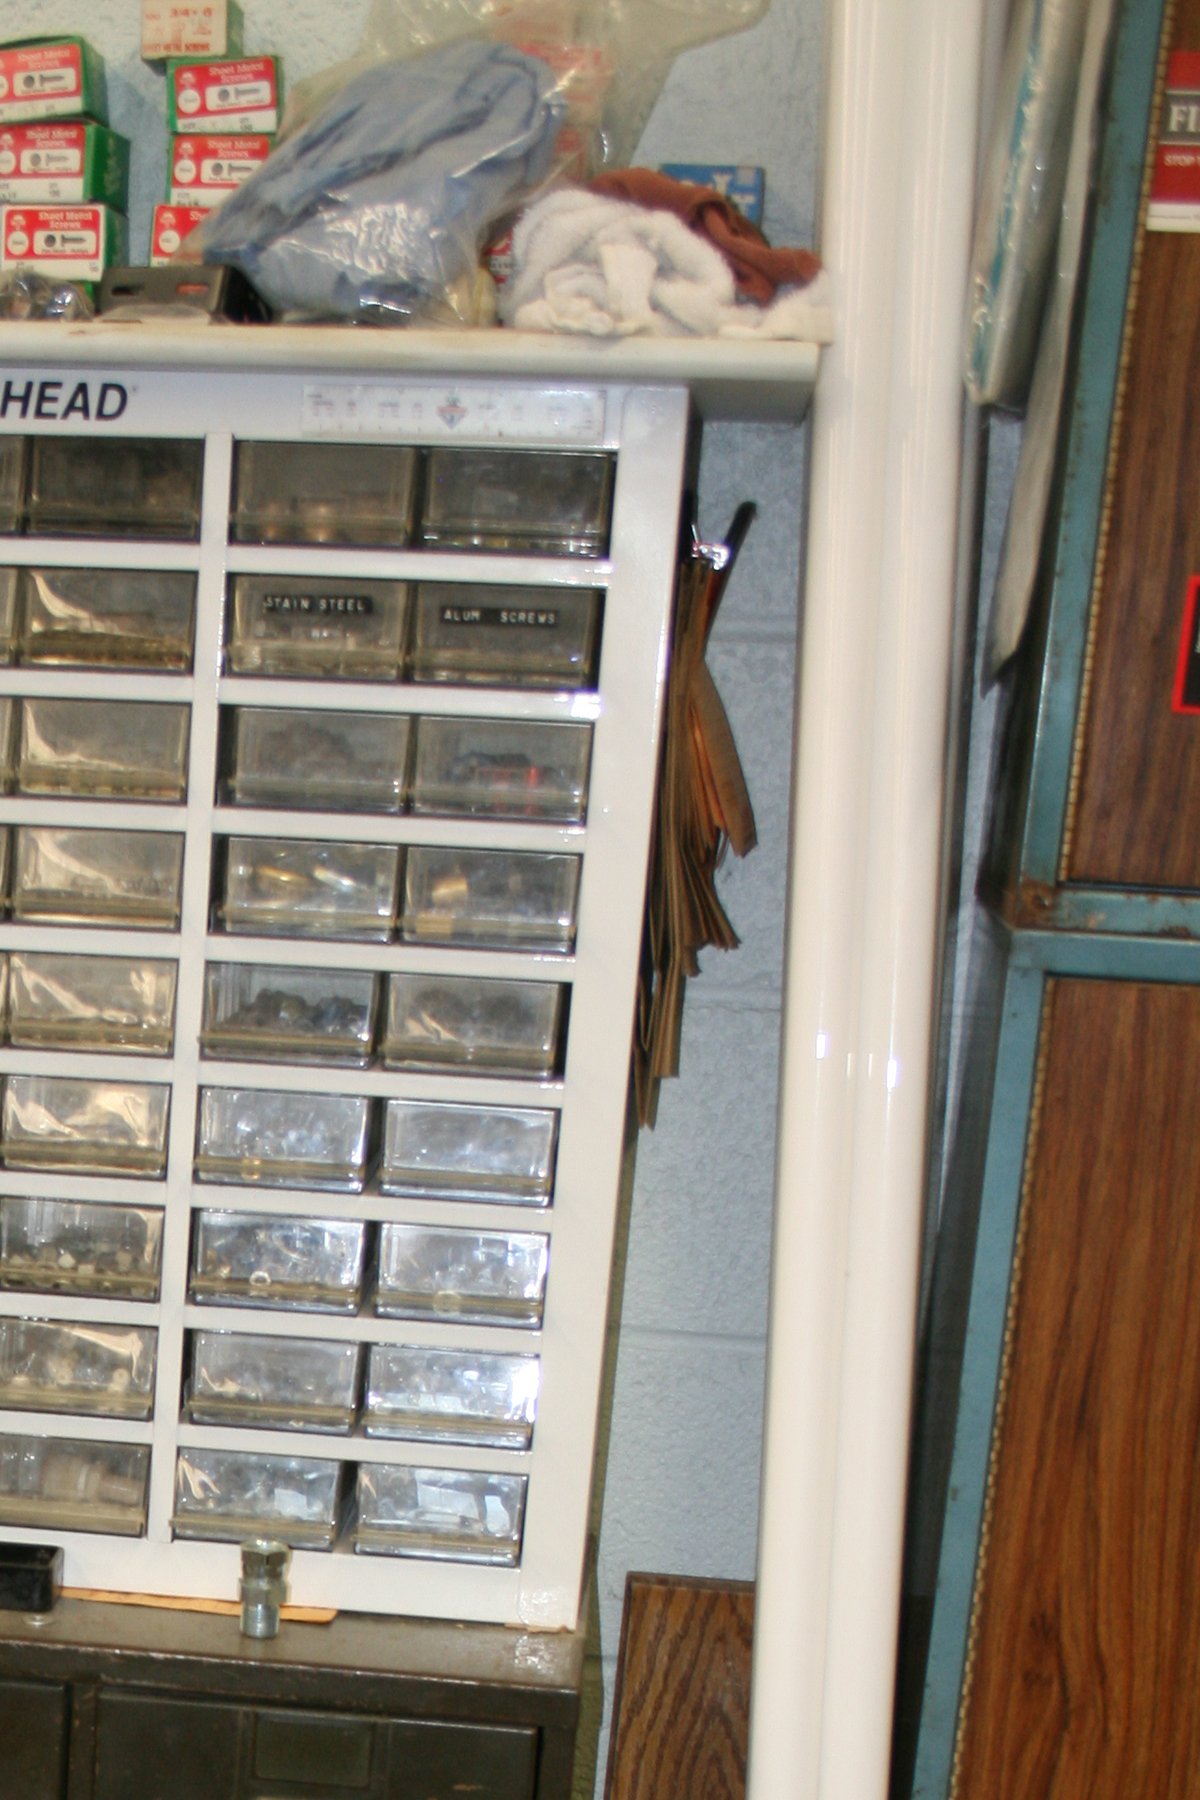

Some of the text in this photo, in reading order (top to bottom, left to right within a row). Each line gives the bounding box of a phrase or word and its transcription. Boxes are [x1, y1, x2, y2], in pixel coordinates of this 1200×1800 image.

[264, 595, 365, 611] STAIN STEEL
[444, 609, 556, 625] ALUM SCREWS
